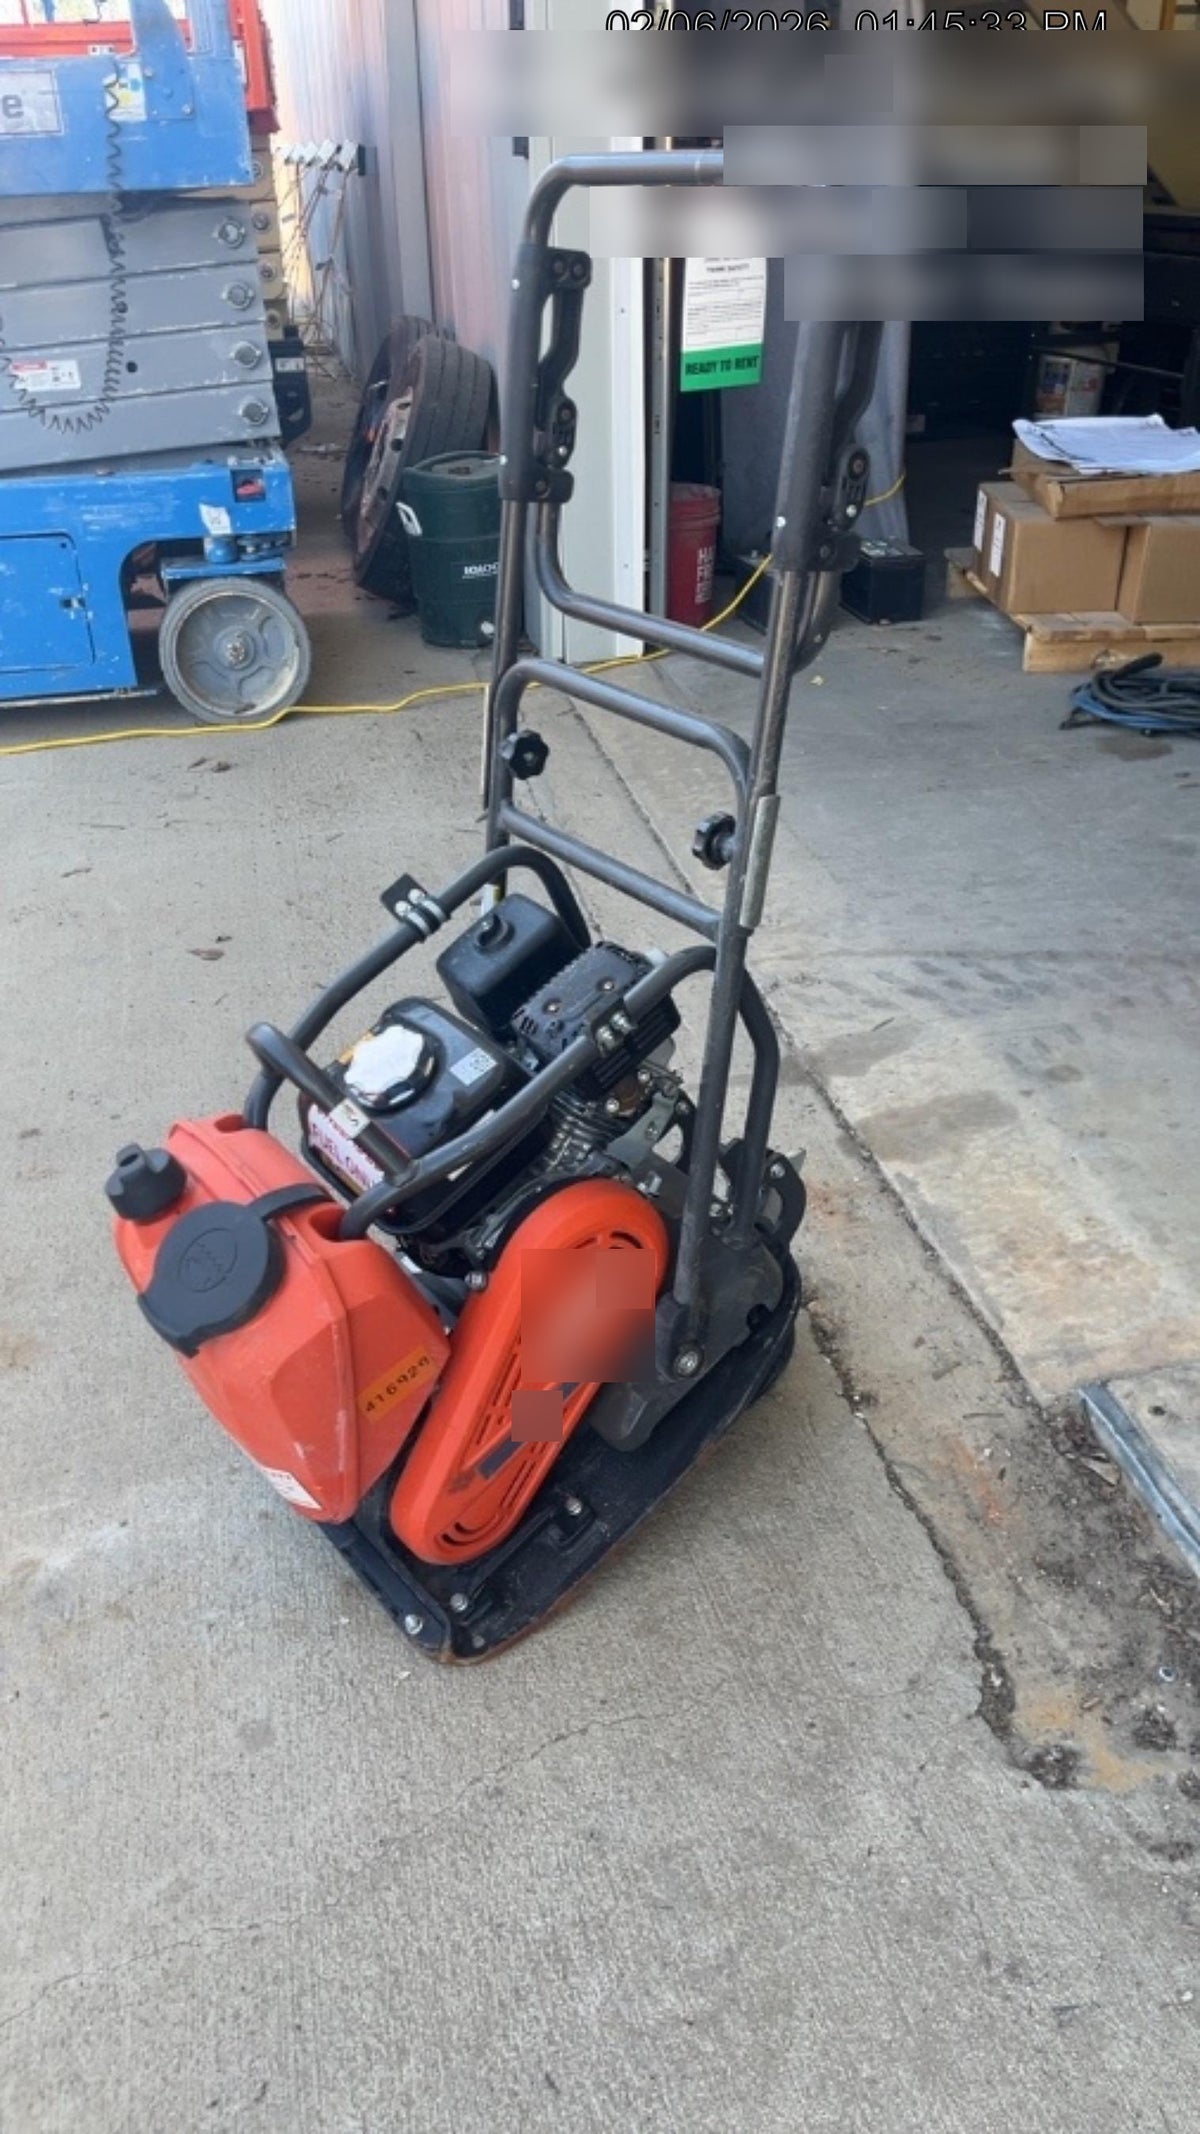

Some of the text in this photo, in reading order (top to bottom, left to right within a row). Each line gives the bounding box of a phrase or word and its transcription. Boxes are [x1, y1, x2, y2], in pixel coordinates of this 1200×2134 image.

[685, 355, 759, 375] READY TO RENT
